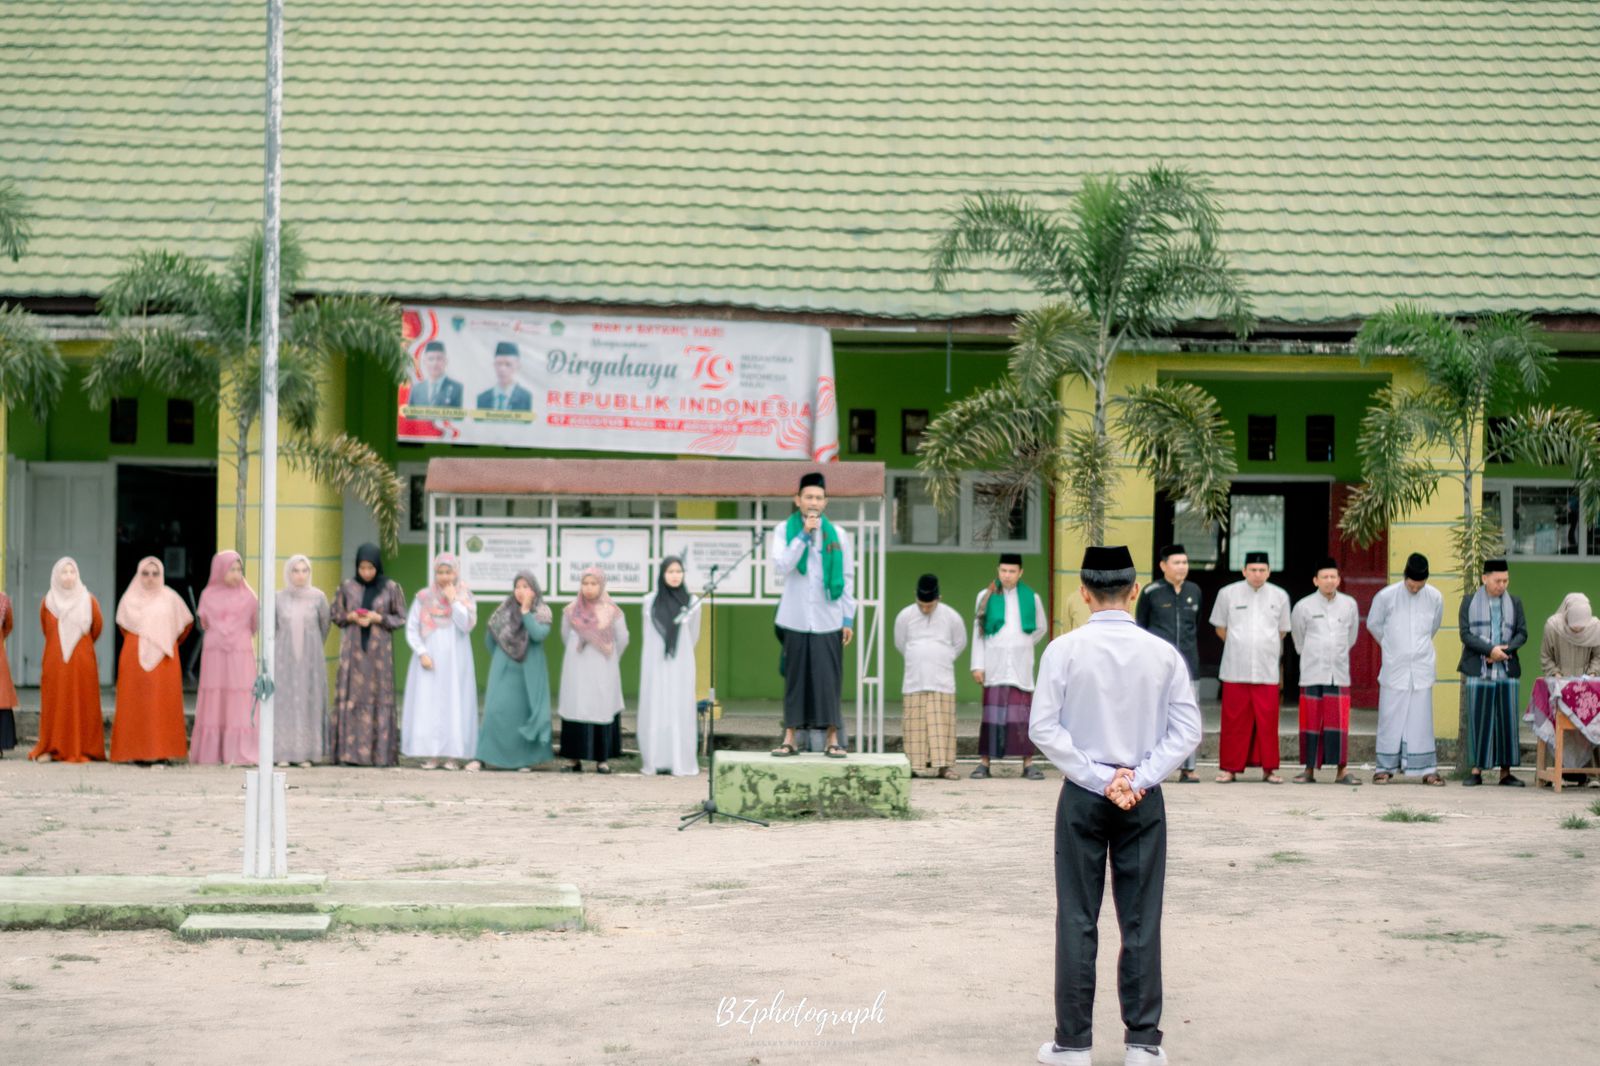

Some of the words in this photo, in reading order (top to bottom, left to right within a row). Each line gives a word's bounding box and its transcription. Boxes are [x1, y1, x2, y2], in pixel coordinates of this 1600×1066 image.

[637, 324, 688, 336] BATANG
[693, 326, 725, 337] HARI
[546, 350, 677, 390] Dirgahayu
[546, 389, 670, 413] REPUBLIK
[679, 396, 813, 420] INDONESIA
[569, 415, 624, 428] AGUSTUS
